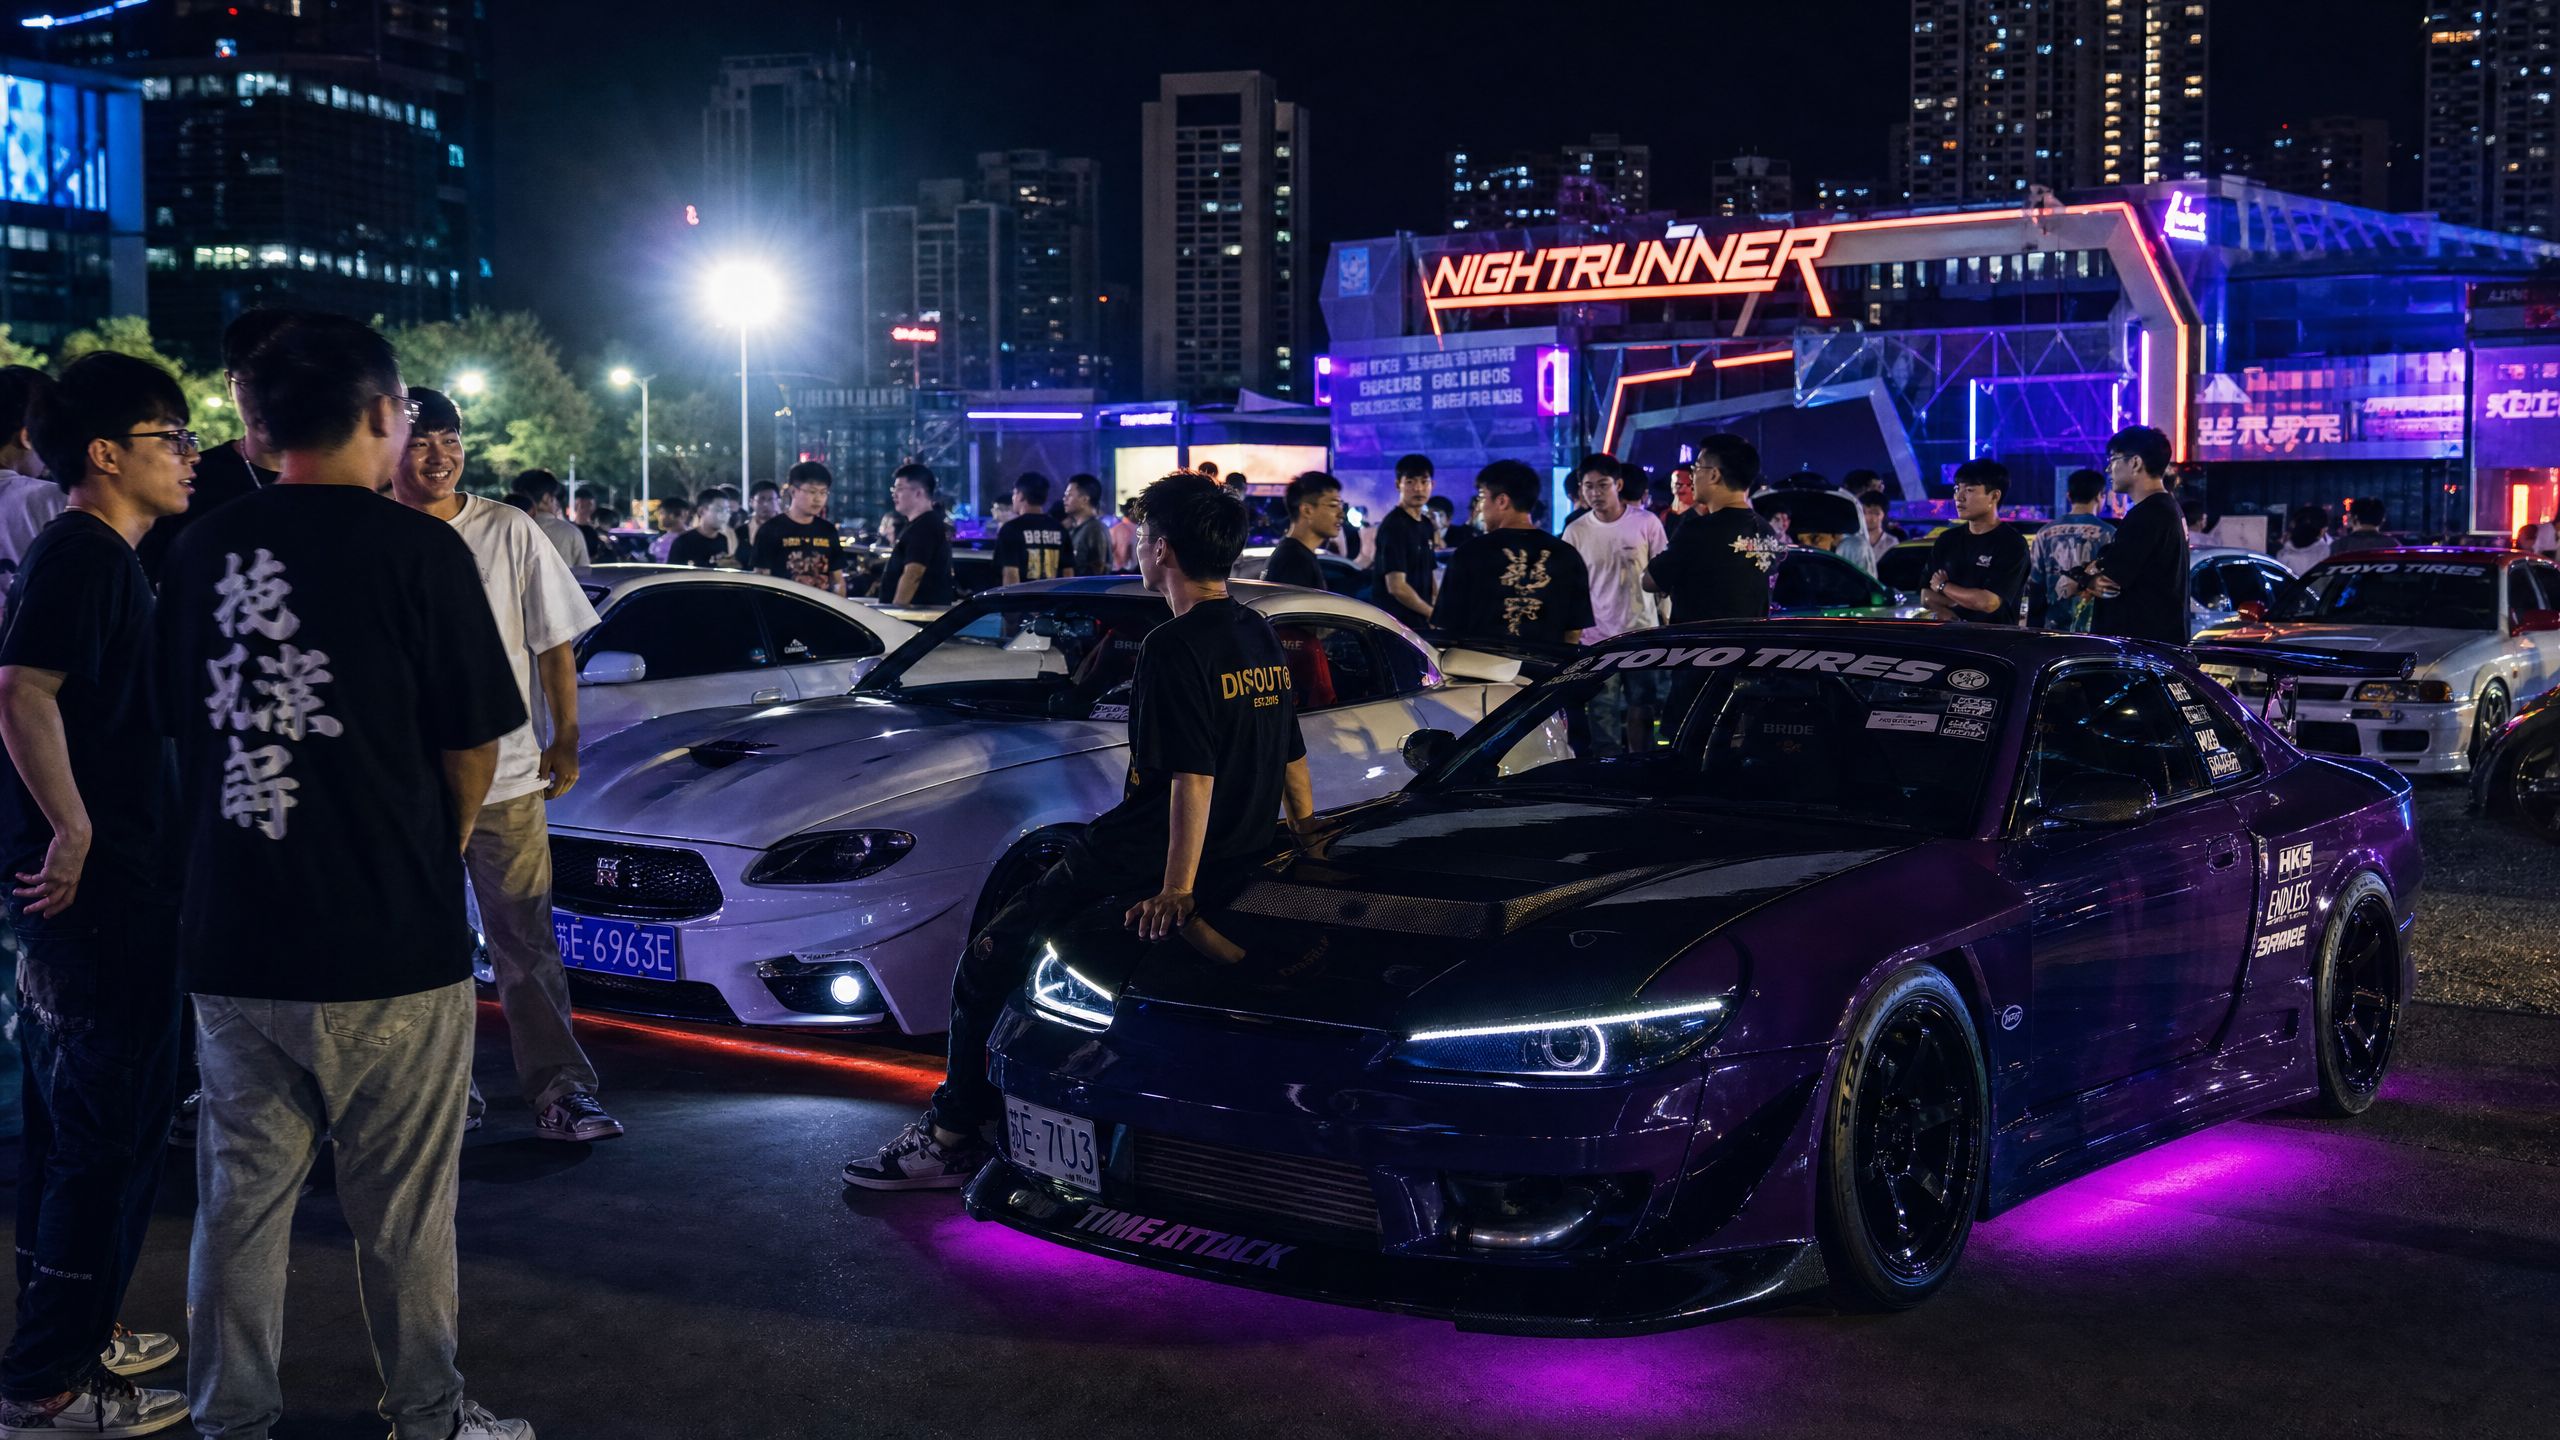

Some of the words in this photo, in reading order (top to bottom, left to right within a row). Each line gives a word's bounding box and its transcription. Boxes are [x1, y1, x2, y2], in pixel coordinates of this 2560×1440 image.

[1431, 229, 1832, 317] NIGHTRUNNER
[2324, 563, 2399, 576] TOYO
[2403, 563, 2487, 577] TIRES
[1590, 646, 1748, 671] TOYO
[1747, 647, 1947, 683] TIRES
[1763, 723, 1815, 735] BRIDE
[2279, 845, 2313, 873] HKS
[2267, 880, 2312, 921] ENDLESS
[1073, 1204, 1167, 1244] TIME
[1155, 1220, 1298, 1271] ATTACK
